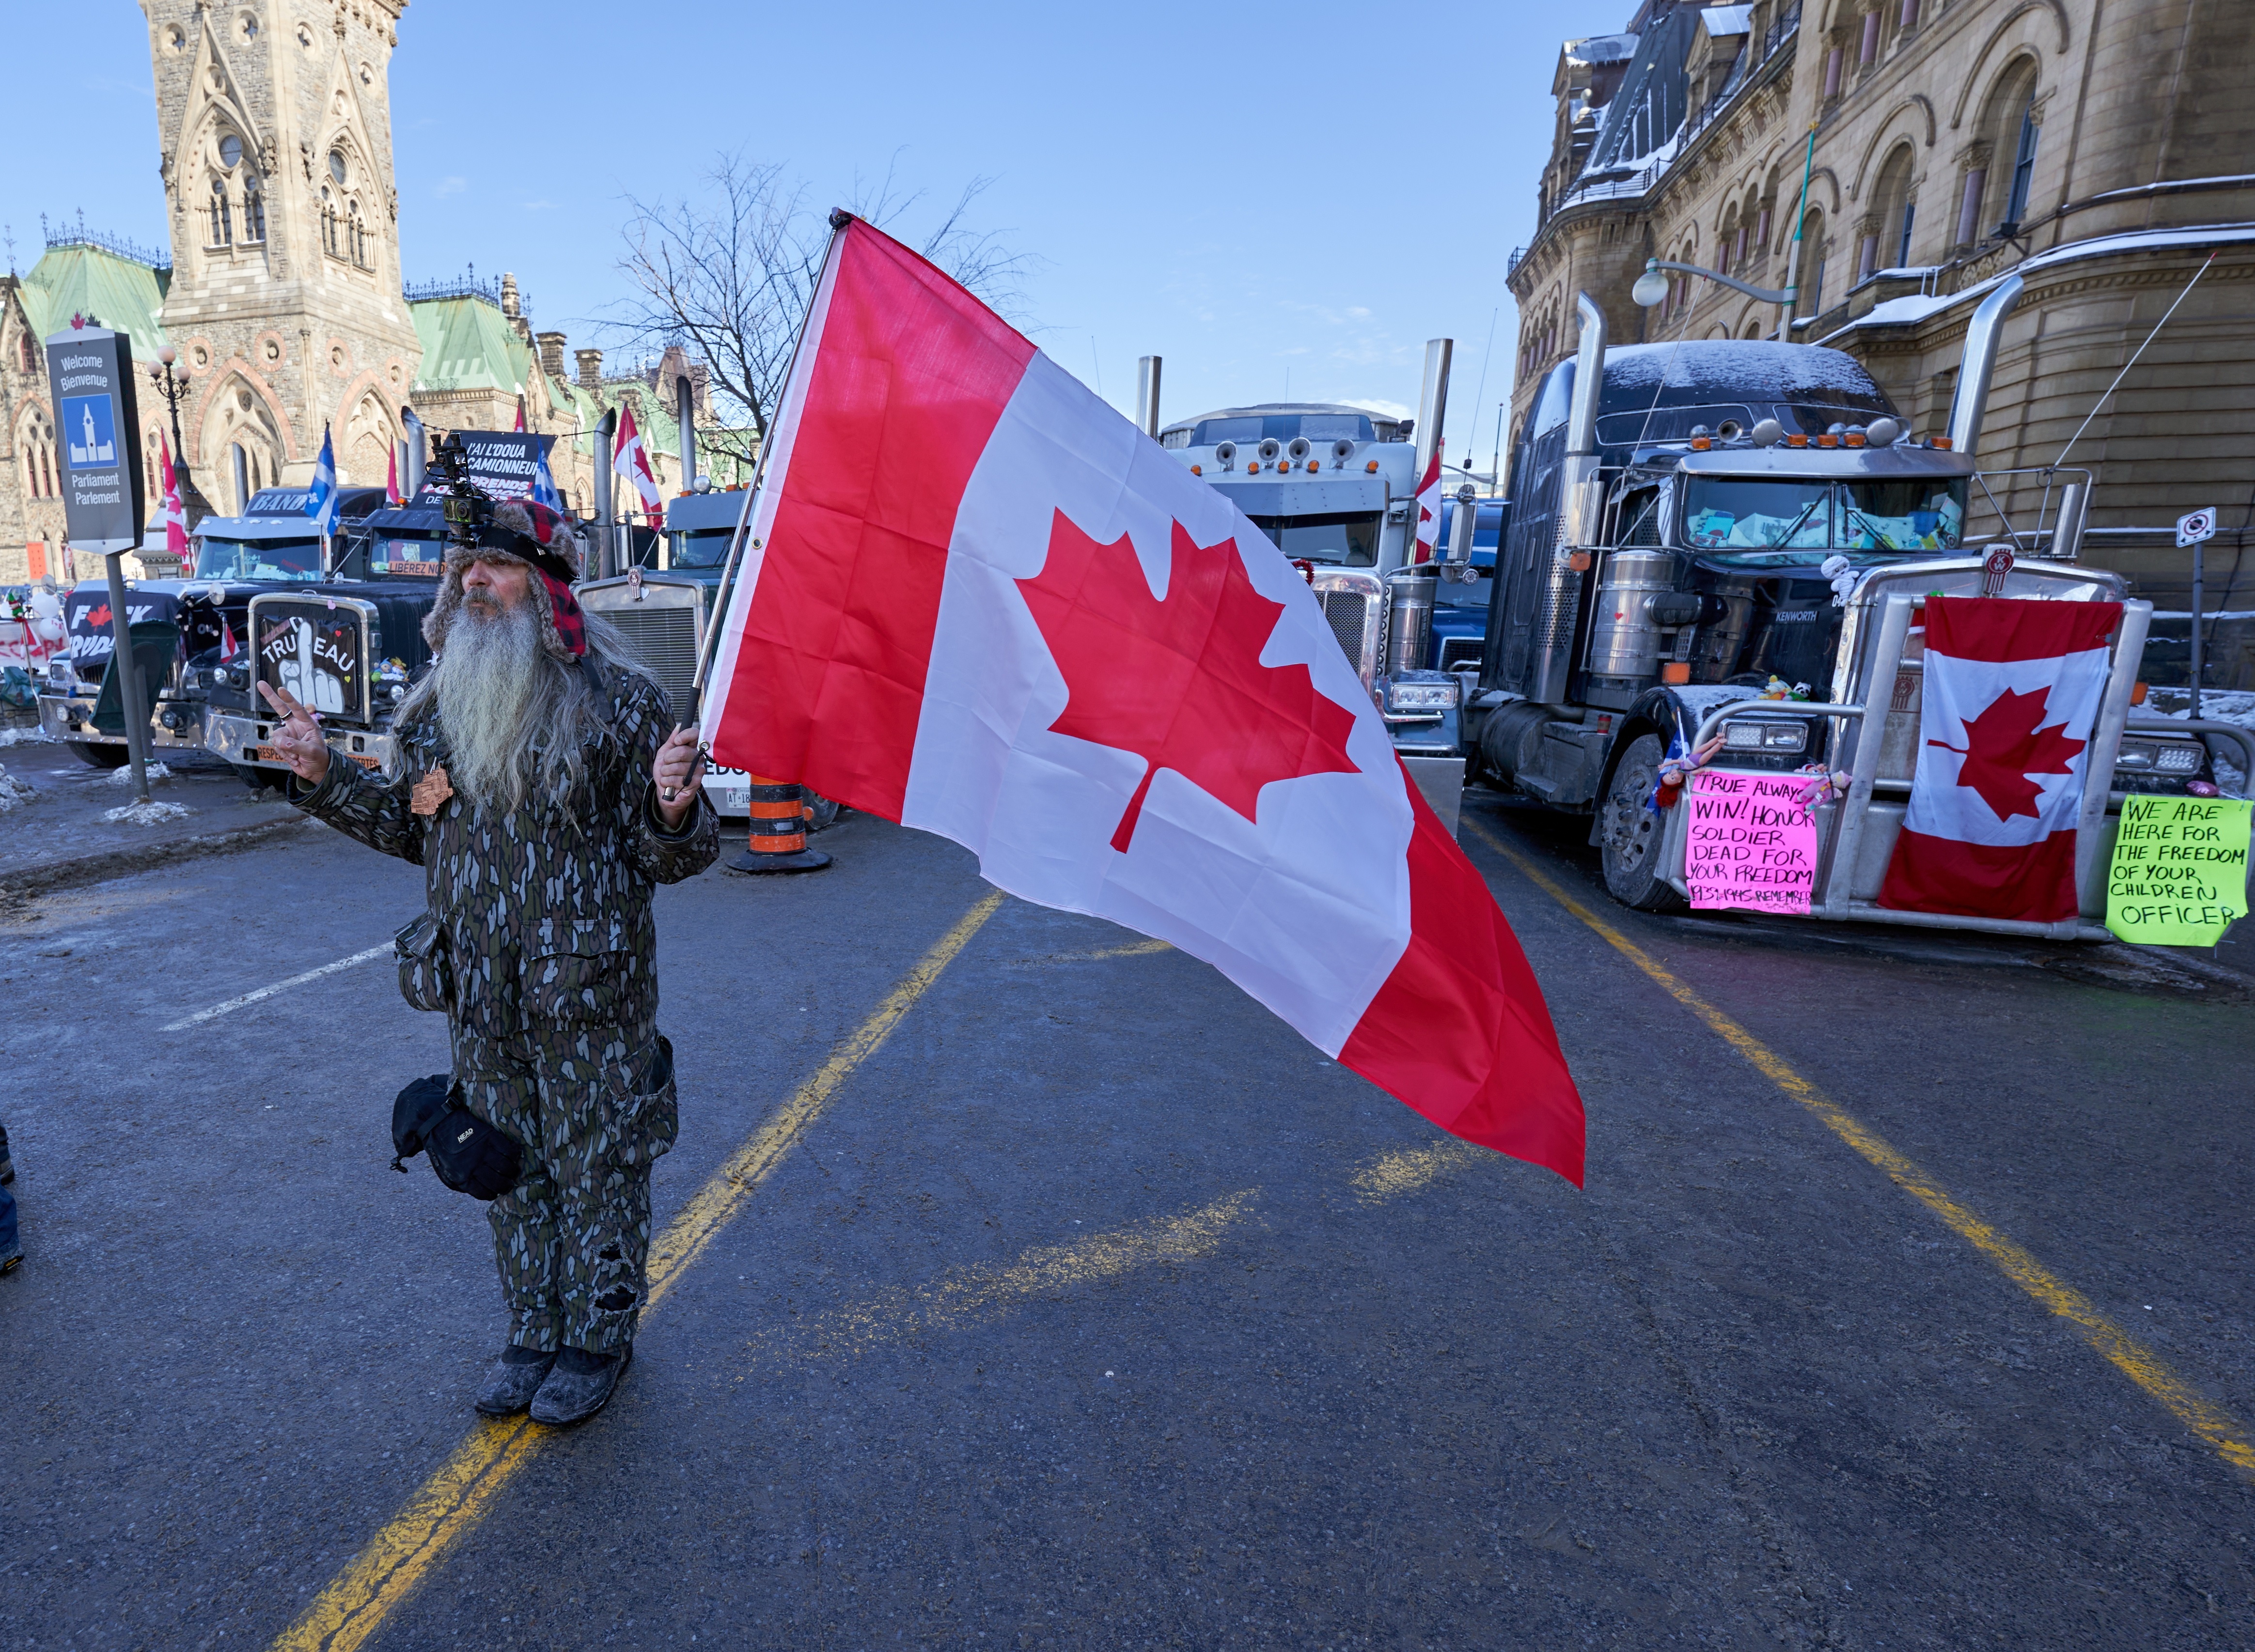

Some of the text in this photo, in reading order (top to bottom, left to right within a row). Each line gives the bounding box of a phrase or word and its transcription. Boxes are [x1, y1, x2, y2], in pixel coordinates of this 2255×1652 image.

[61, 355, 103, 372] Welcome
[61, 374, 108, 391] Bienvenue
[485, 444, 526, 458] L'DOUA
[72, 472, 120, 488] Parliament
[75, 490, 120, 505] Parlement
[425, 496, 442, 504] DE
[1776, 610, 1817, 622] KENWORTH
[1699, 774, 1747, 793] TRUE
[2128, 800, 2224, 822] WE ARE
[2123, 823, 2220, 842] HERE FOR
[1694, 845, 1807, 866] DEAD FOR
[2116, 845, 2245, 865] THE FREEDOM
[1691, 862, 1813, 885] YOUR FREEDOM
[2114, 865, 2203, 885] OF YOUR
[1755, 890, 1811, 905] REMEMBER
[2111, 883, 2217, 901] CHILDREN
[457, 1128, 473, 1143] HEAD
